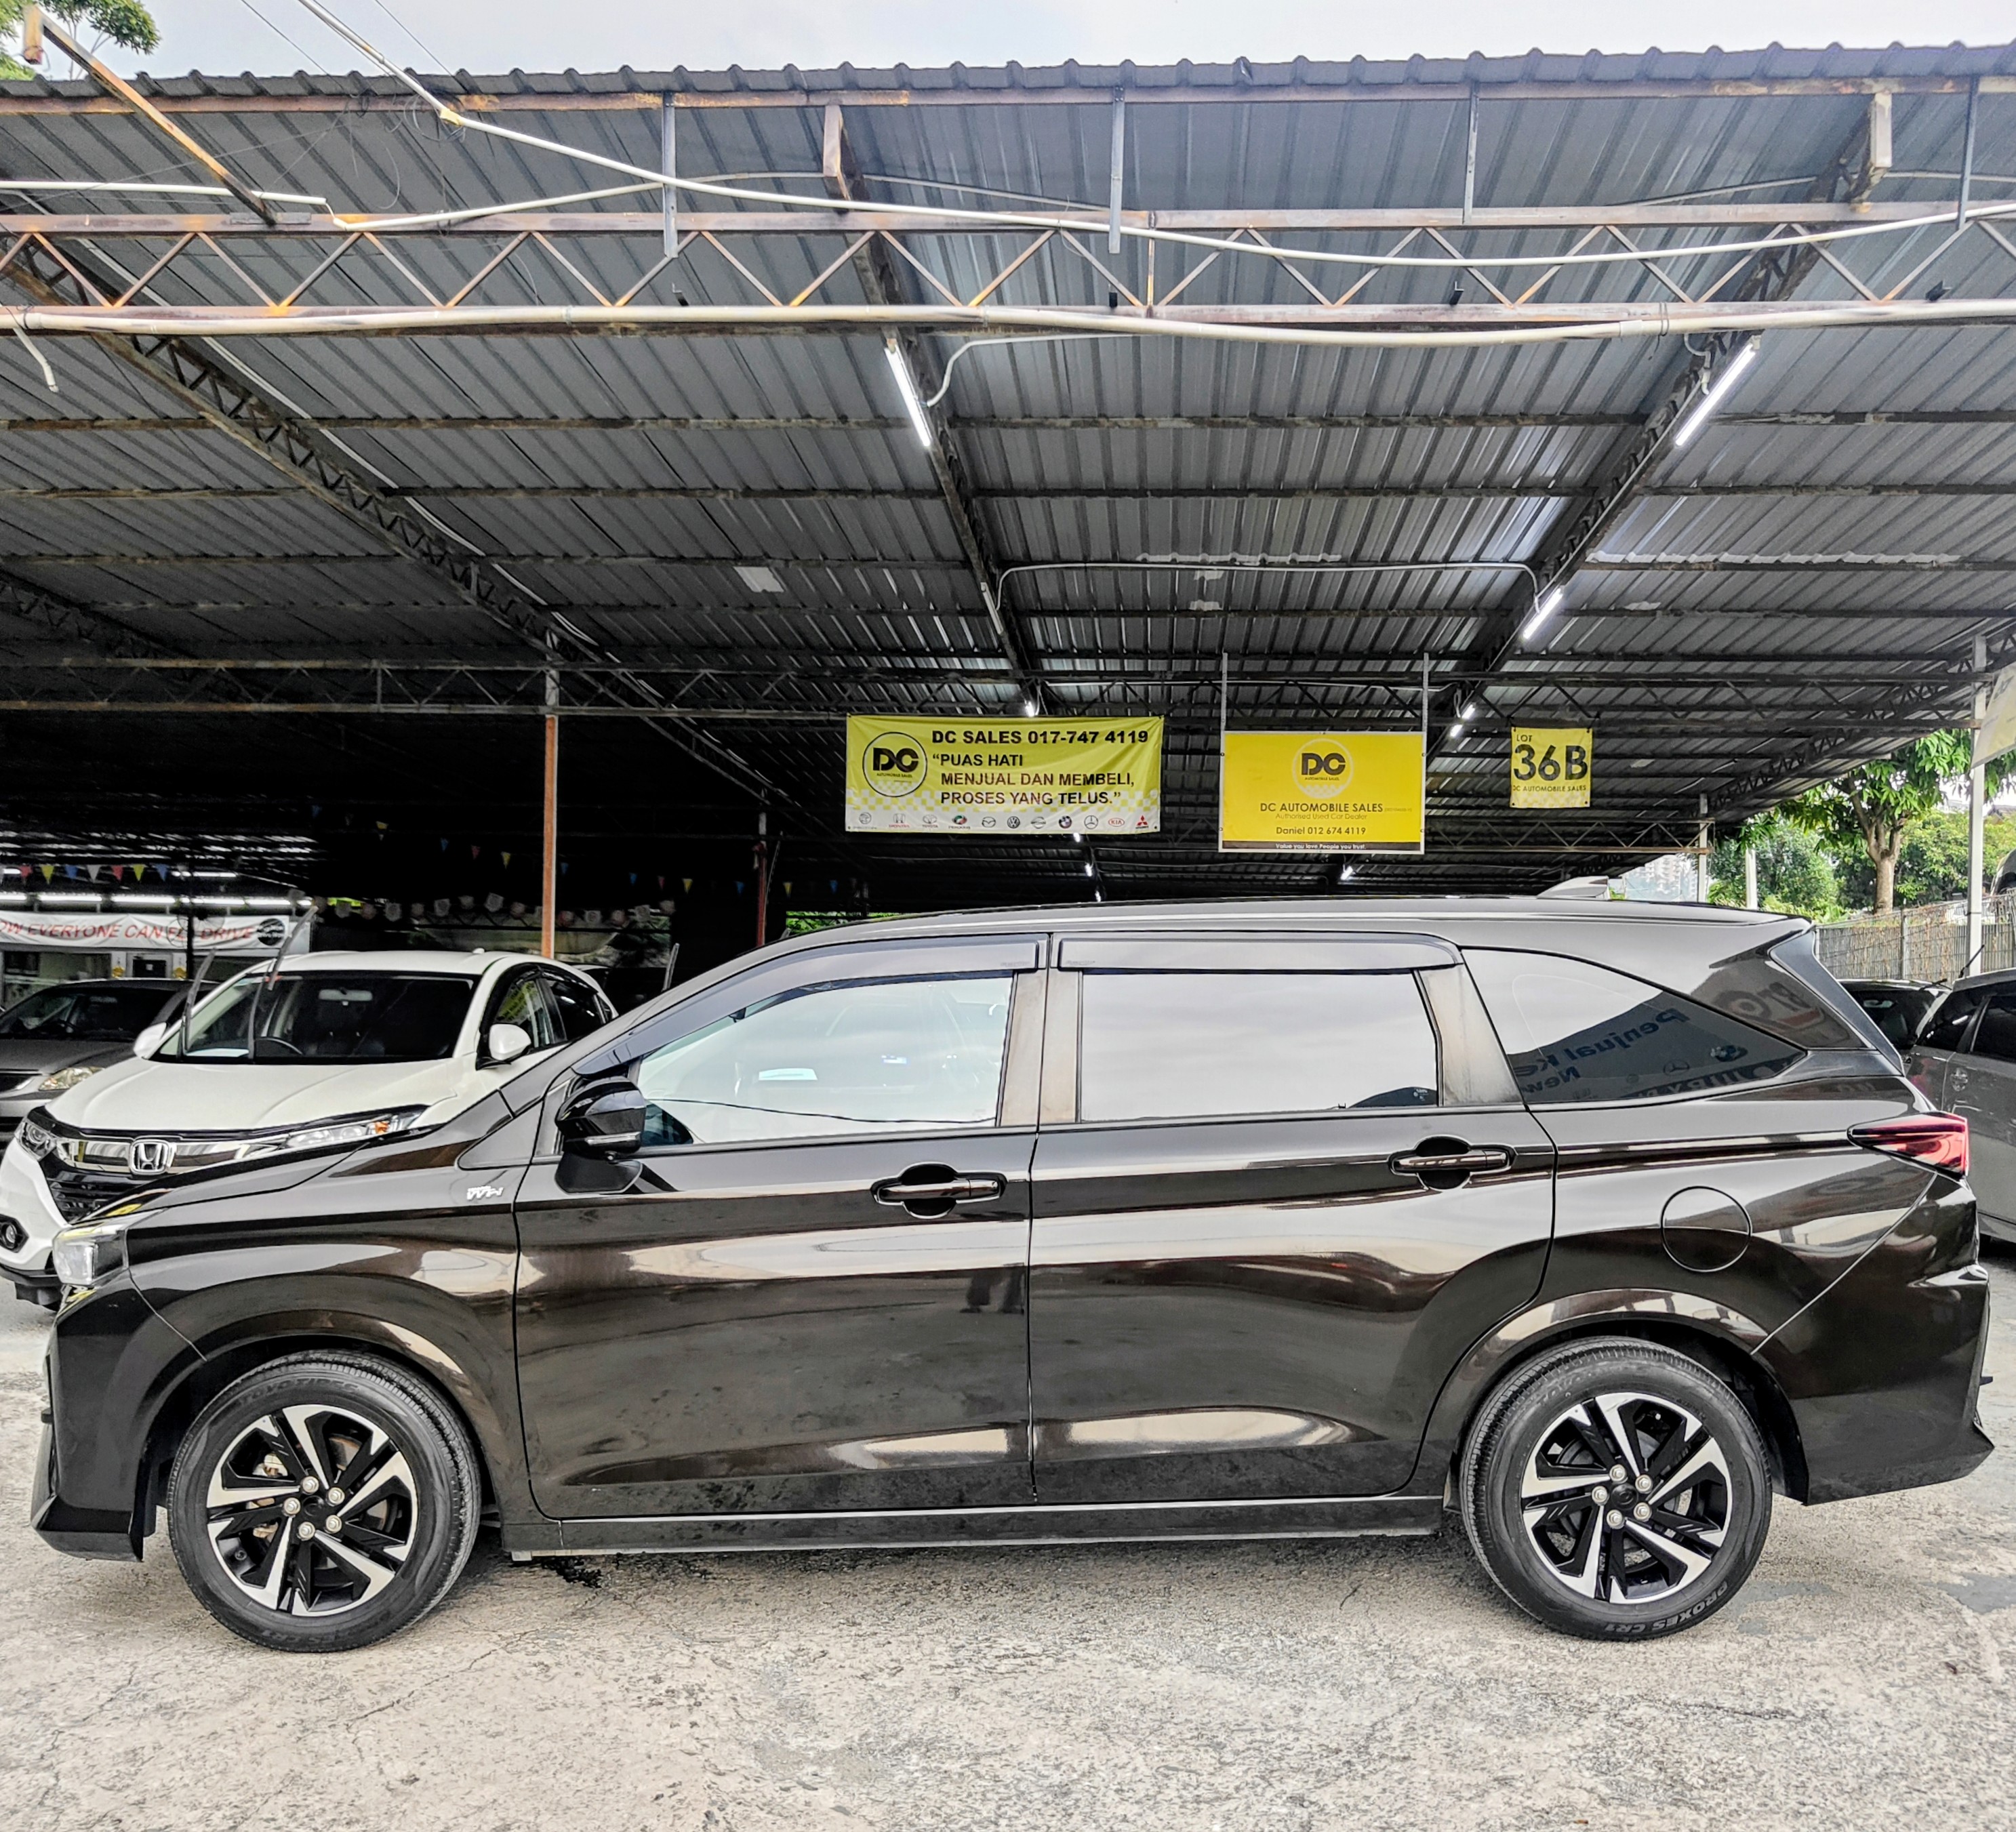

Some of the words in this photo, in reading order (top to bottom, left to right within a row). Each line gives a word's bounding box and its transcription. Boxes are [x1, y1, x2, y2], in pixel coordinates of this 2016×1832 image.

[932, 730, 956, 744] DC
[963, 730, 1022, 744] SALES
[1028, 730, 1100, 744] 017-747
[1104, 730, 1148, 744] 4119
[1516, 734, 1533, 742] LOT
[872, 747, 919, 773] DC
[988, 754, 1024, 767] HATI
[1301, 752, 1346, 776] DC
[1513, 744, 1588, 781] 36B
[941, 773, 1016, 786] MENJUAL
[1020, 773, 1054, 786] DAN
[1059, 772, 1135, 788] MEMBELI,
[941, 792, 1005, 805] PROSES
[1009, 792, 1053, 805] YANG
[1259, 802, 1276, 812] DC
[1279, 802, 1350, 813] AUTOMOBILE
[1352, 802, 1384, 813] SALES
[1276, 826, 1306, 834] Daniel
[1307, 827, 1324, 835] 012
[1326, 827, 1343, 835] 674
[1344, 827, 1367, 835] 4119
[27, 923, 123, 939] EVERYONE
[124, 924, 164, 939] CAN
[1651, 1581, 1729, 1631] PROXES
[1604, 1623, 1647, 1633] CR1
